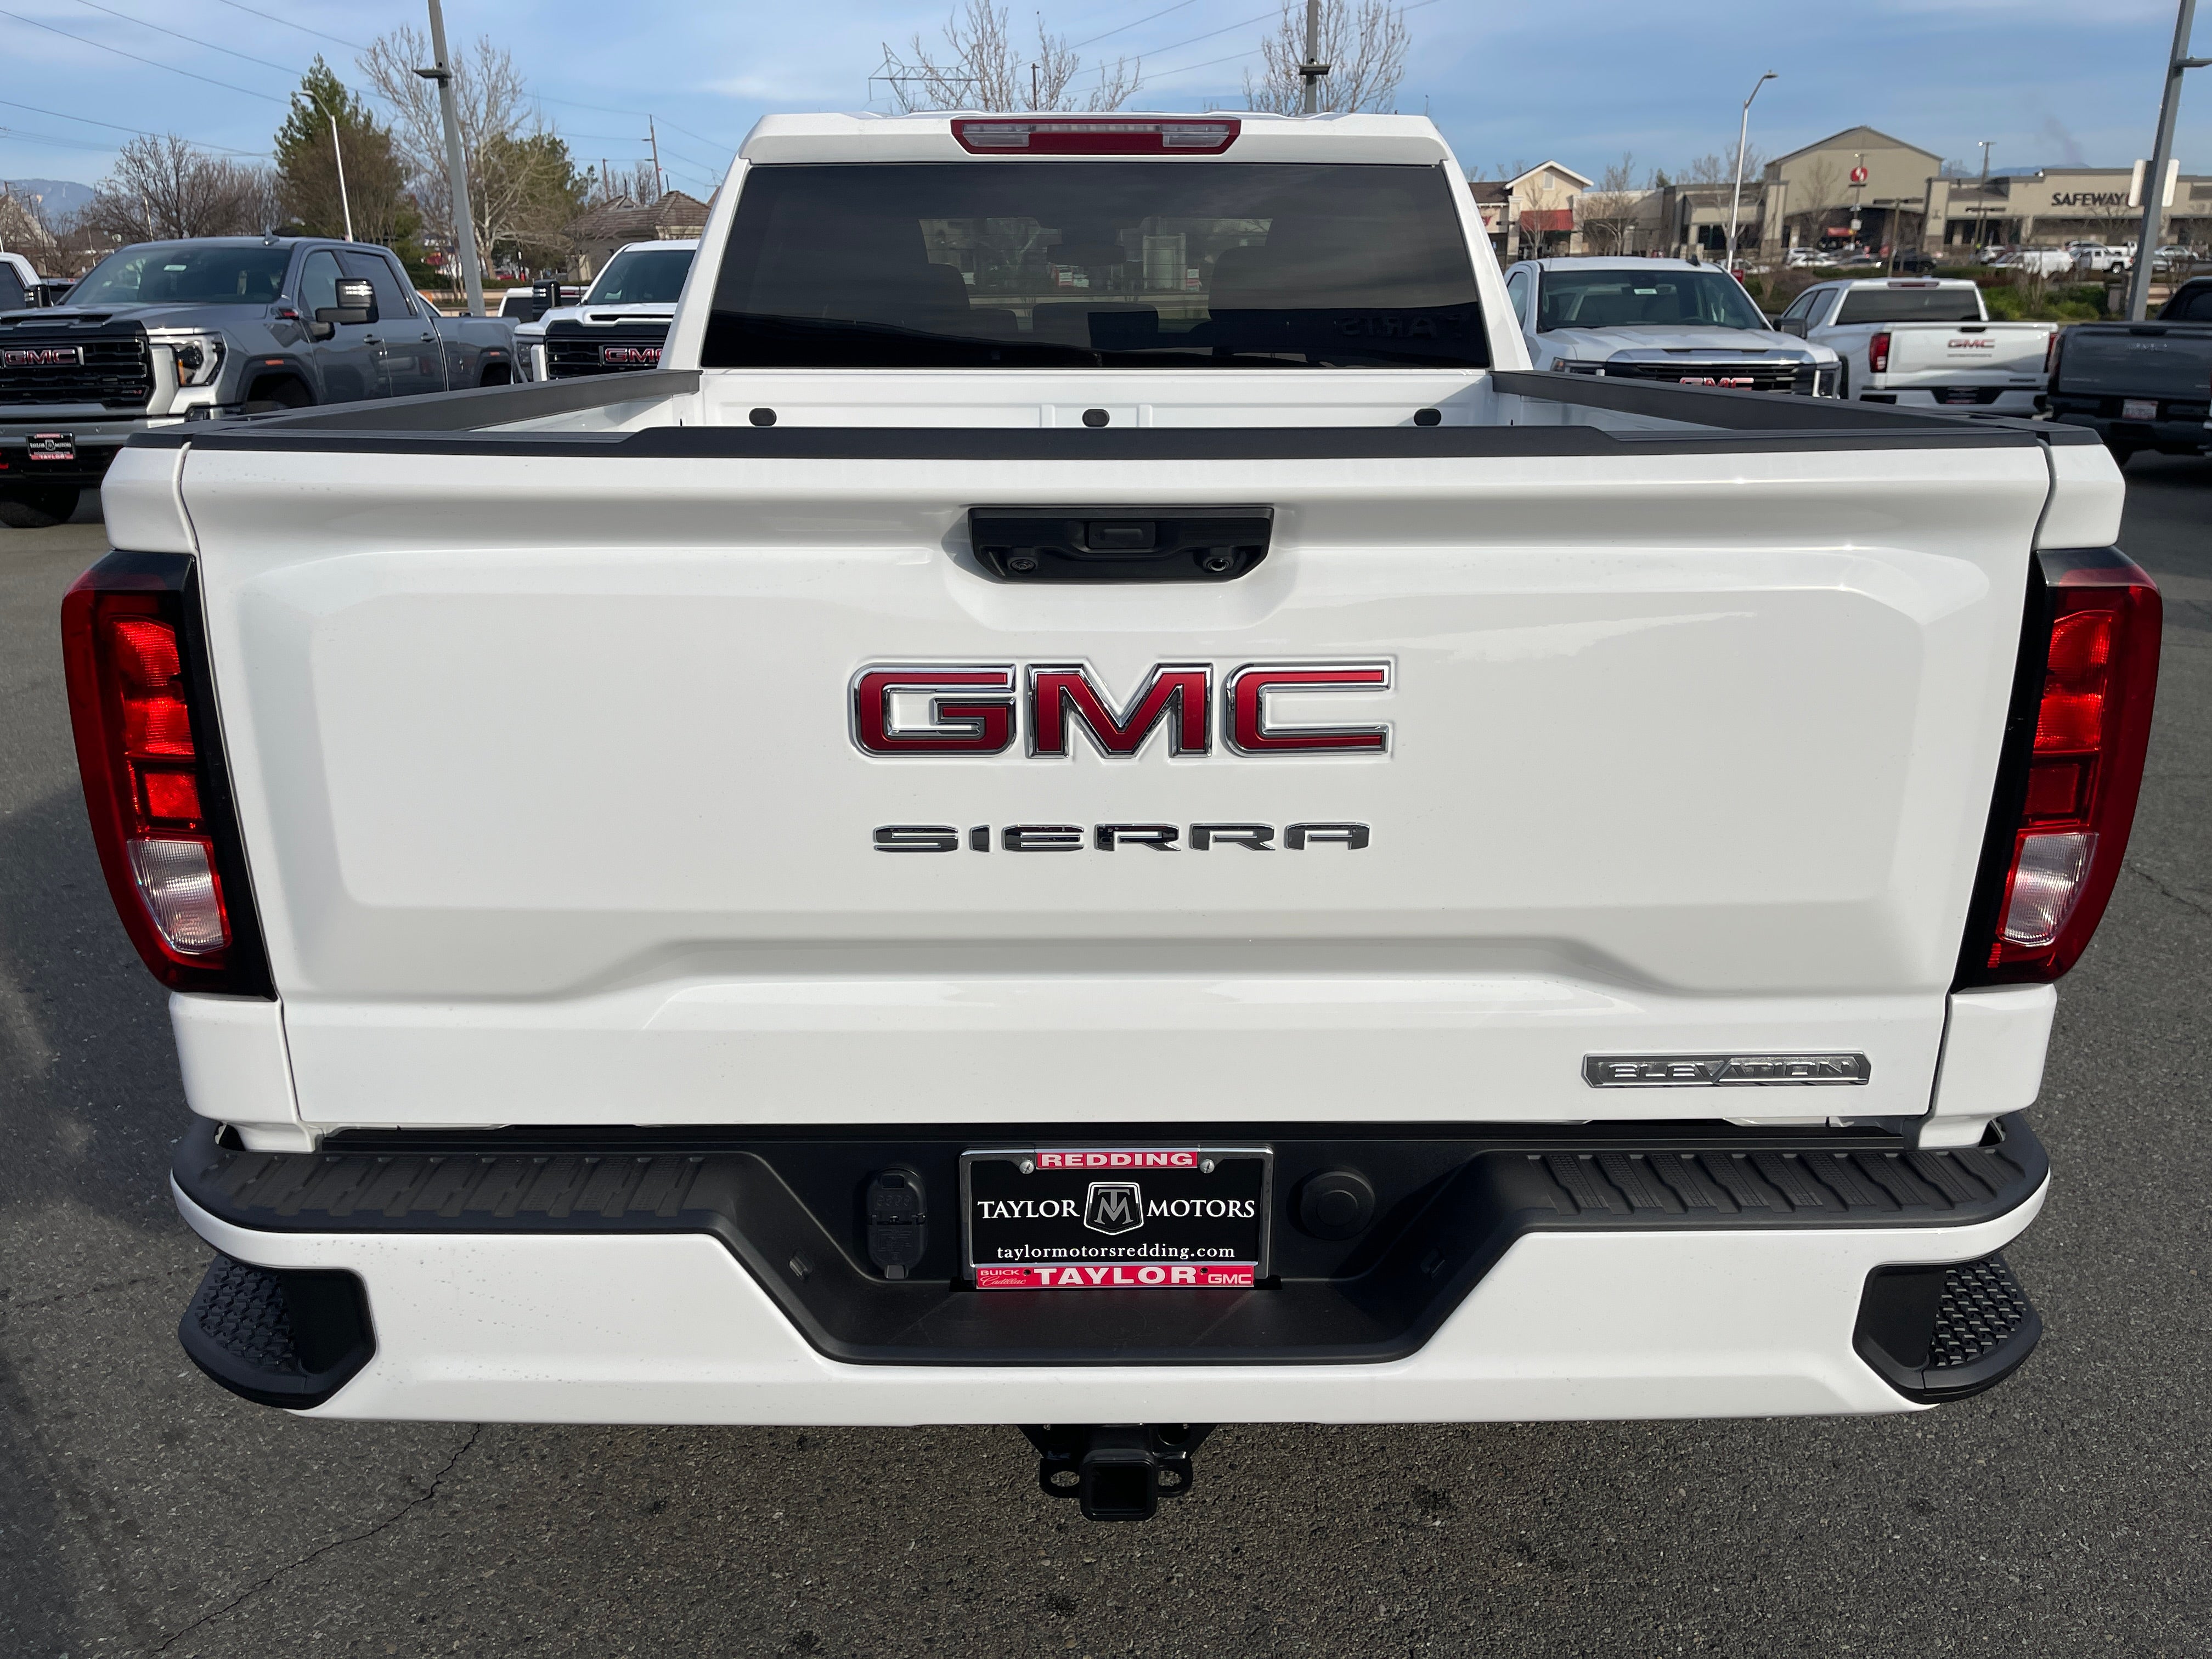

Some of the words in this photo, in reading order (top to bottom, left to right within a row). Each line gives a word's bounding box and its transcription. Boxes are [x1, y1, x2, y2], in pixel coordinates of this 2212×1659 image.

[2051, 193, 2124, 206] SAFEWAY
[1948, 339, 1995, 348] GMC
[5, 349, 76, 365] GMC
[850, 659, 1393, 759] GMC
[872, 822, 1372, 852] SIERRA
[1607, 1059, 1851, 1079] ELEVATION
[1041, 1153, 1193, 1167] REDDING
[977, 1200, 1080, 1219] TAYLOR
[1146, 1199, 1255, 1218] MOTORS
[997, 1243, 1235, 1261] taylormotorsredding.com
[980, 1276, 1026, 1286] Cadillac
[1033, 1267, 1197, 1285] TAYLOR
[1207, 1273, 1251, 1285] GMC
